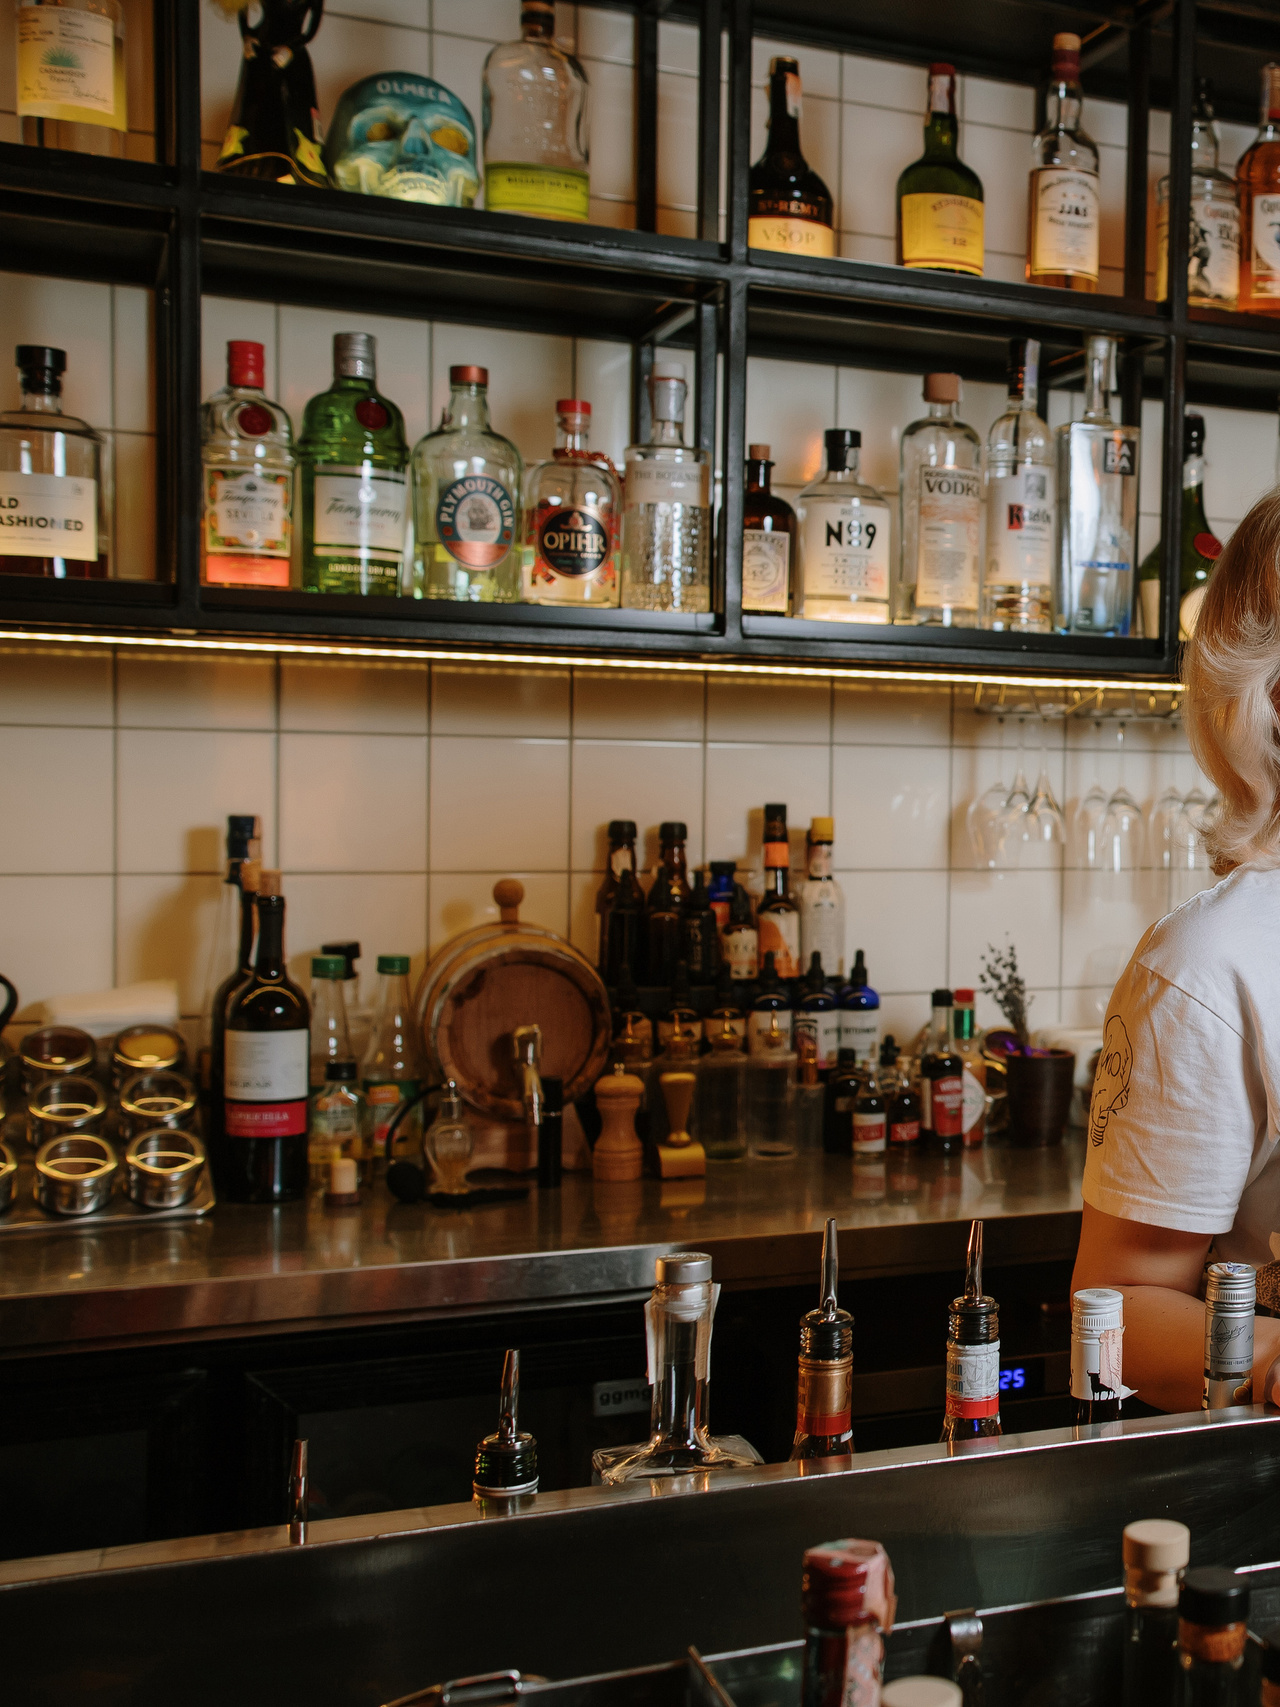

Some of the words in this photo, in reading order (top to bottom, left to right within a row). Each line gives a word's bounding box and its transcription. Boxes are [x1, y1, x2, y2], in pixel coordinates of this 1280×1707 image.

[376, 79, 452, 106] OLMECA
[762, 227, 816, 244] VSOP
[0, 497, 18, 509] LD
[324, 497, 401, 524] Tanqeray
[440, 478, 504, 524] PLYMOUTH
[0, 515, 84, 531] ASHIONED
[544, 531, 606, 553] OPIHR
